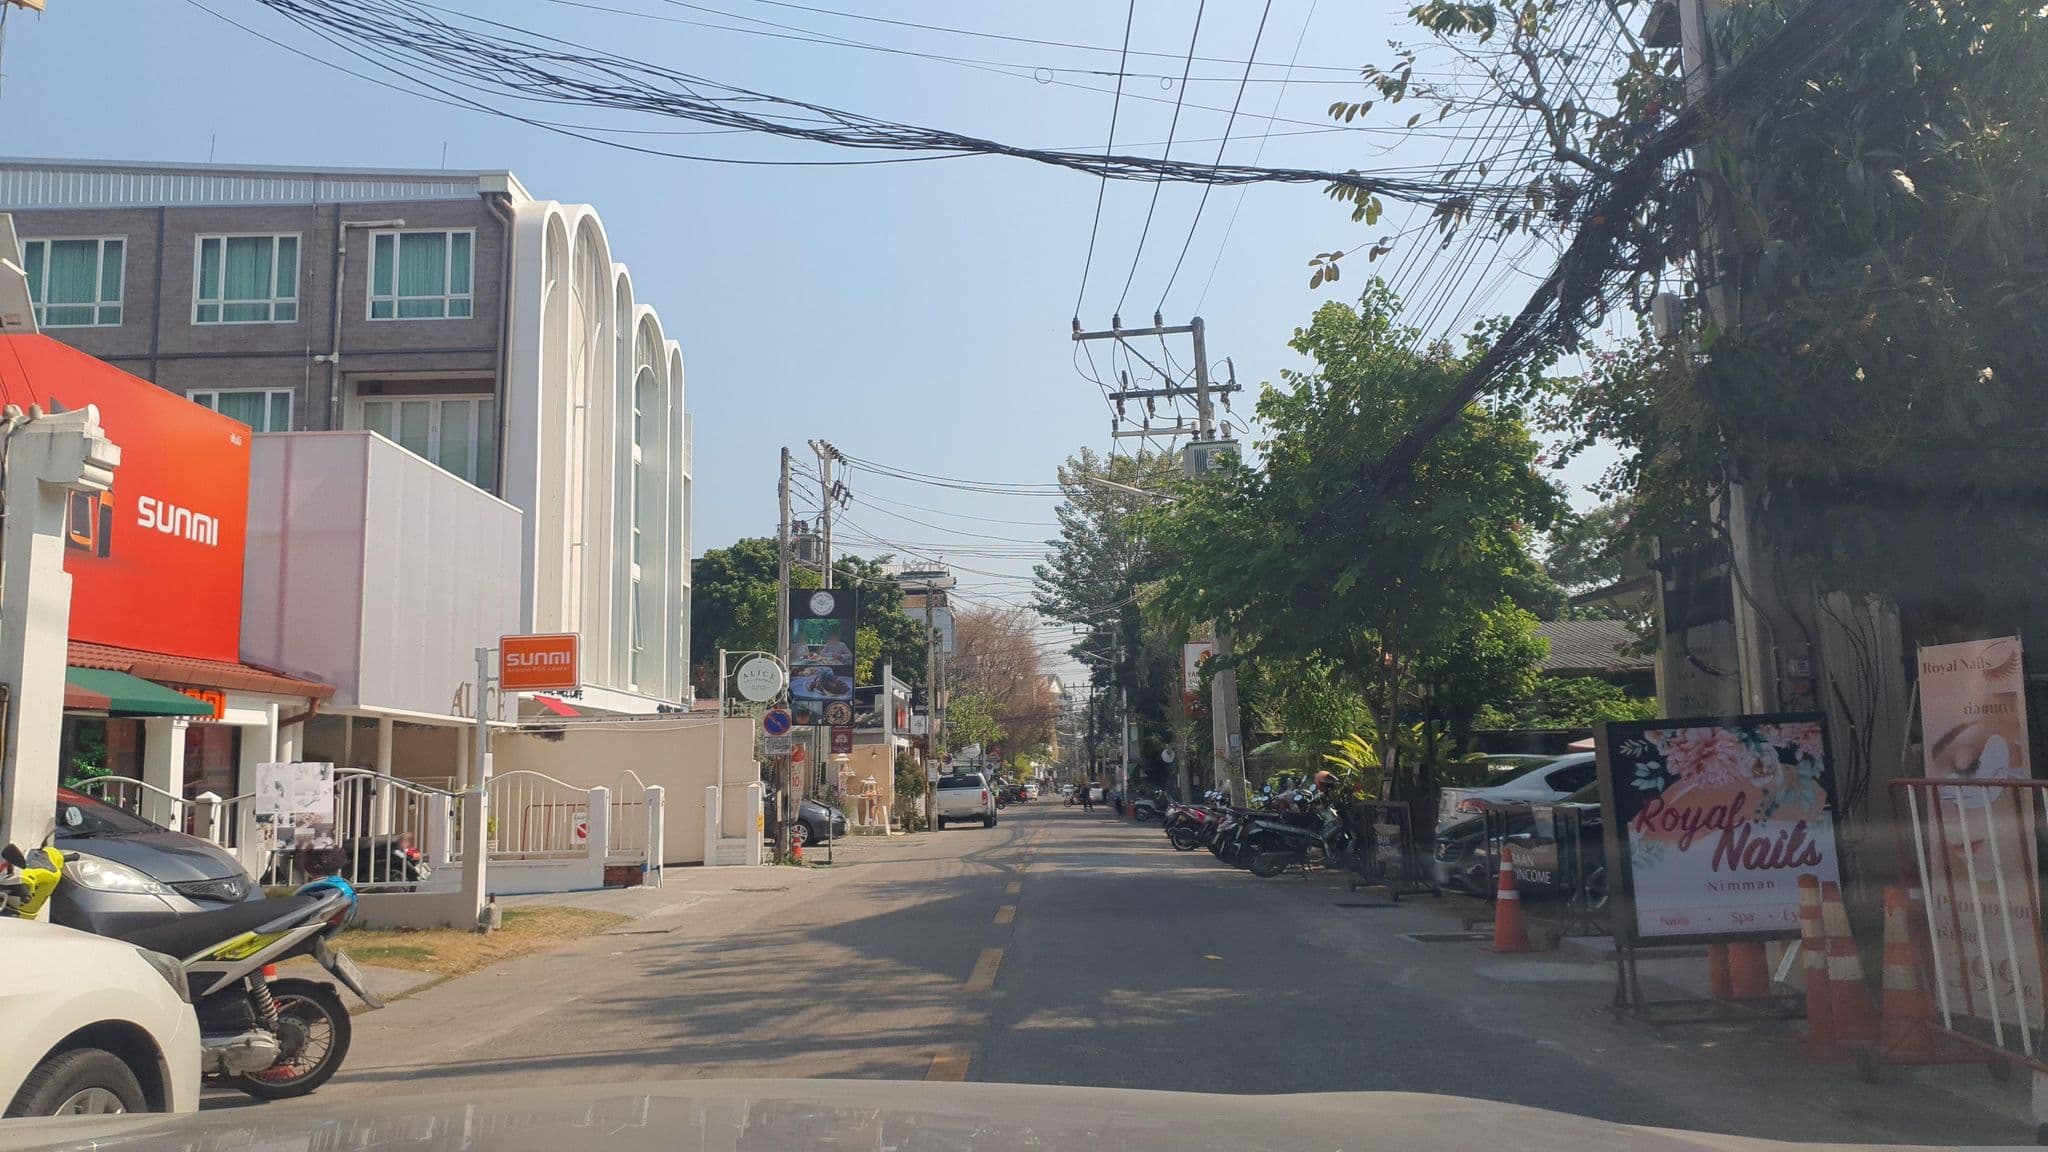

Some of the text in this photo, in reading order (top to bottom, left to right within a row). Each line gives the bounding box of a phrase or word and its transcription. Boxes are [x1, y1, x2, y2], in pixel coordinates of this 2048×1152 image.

[138, 495, 219, 547] SUNMI
[506, 651, 571, 667] SUNMI
[1923, 656, 1992, 676] Royal Nails
[451, 681, 507, 722] ALCE
[1636, 791, 1746, 852] Royal
[1712, 820, 1823, 872] Nails
[1707, 880, 1775, 892] Nimman
[1731, 912, 1755, 926] Spa
